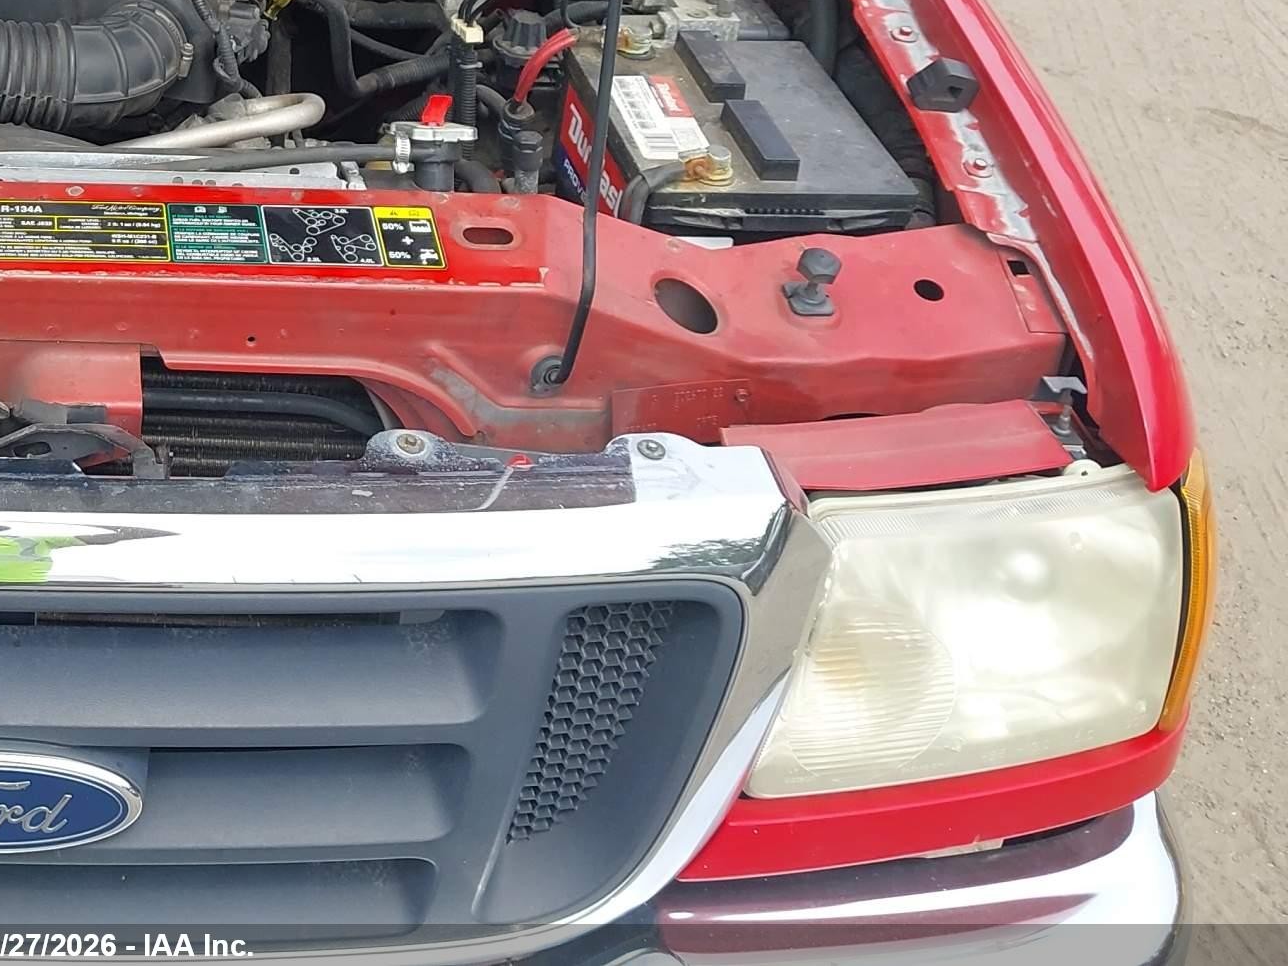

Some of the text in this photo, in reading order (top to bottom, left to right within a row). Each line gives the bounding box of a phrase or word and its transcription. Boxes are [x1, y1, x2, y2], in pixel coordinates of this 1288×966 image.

[0, 205, 43, 213] R-134A
[381, 222, 405, 231] 50%
[388, 251, 412, 260] 50%
